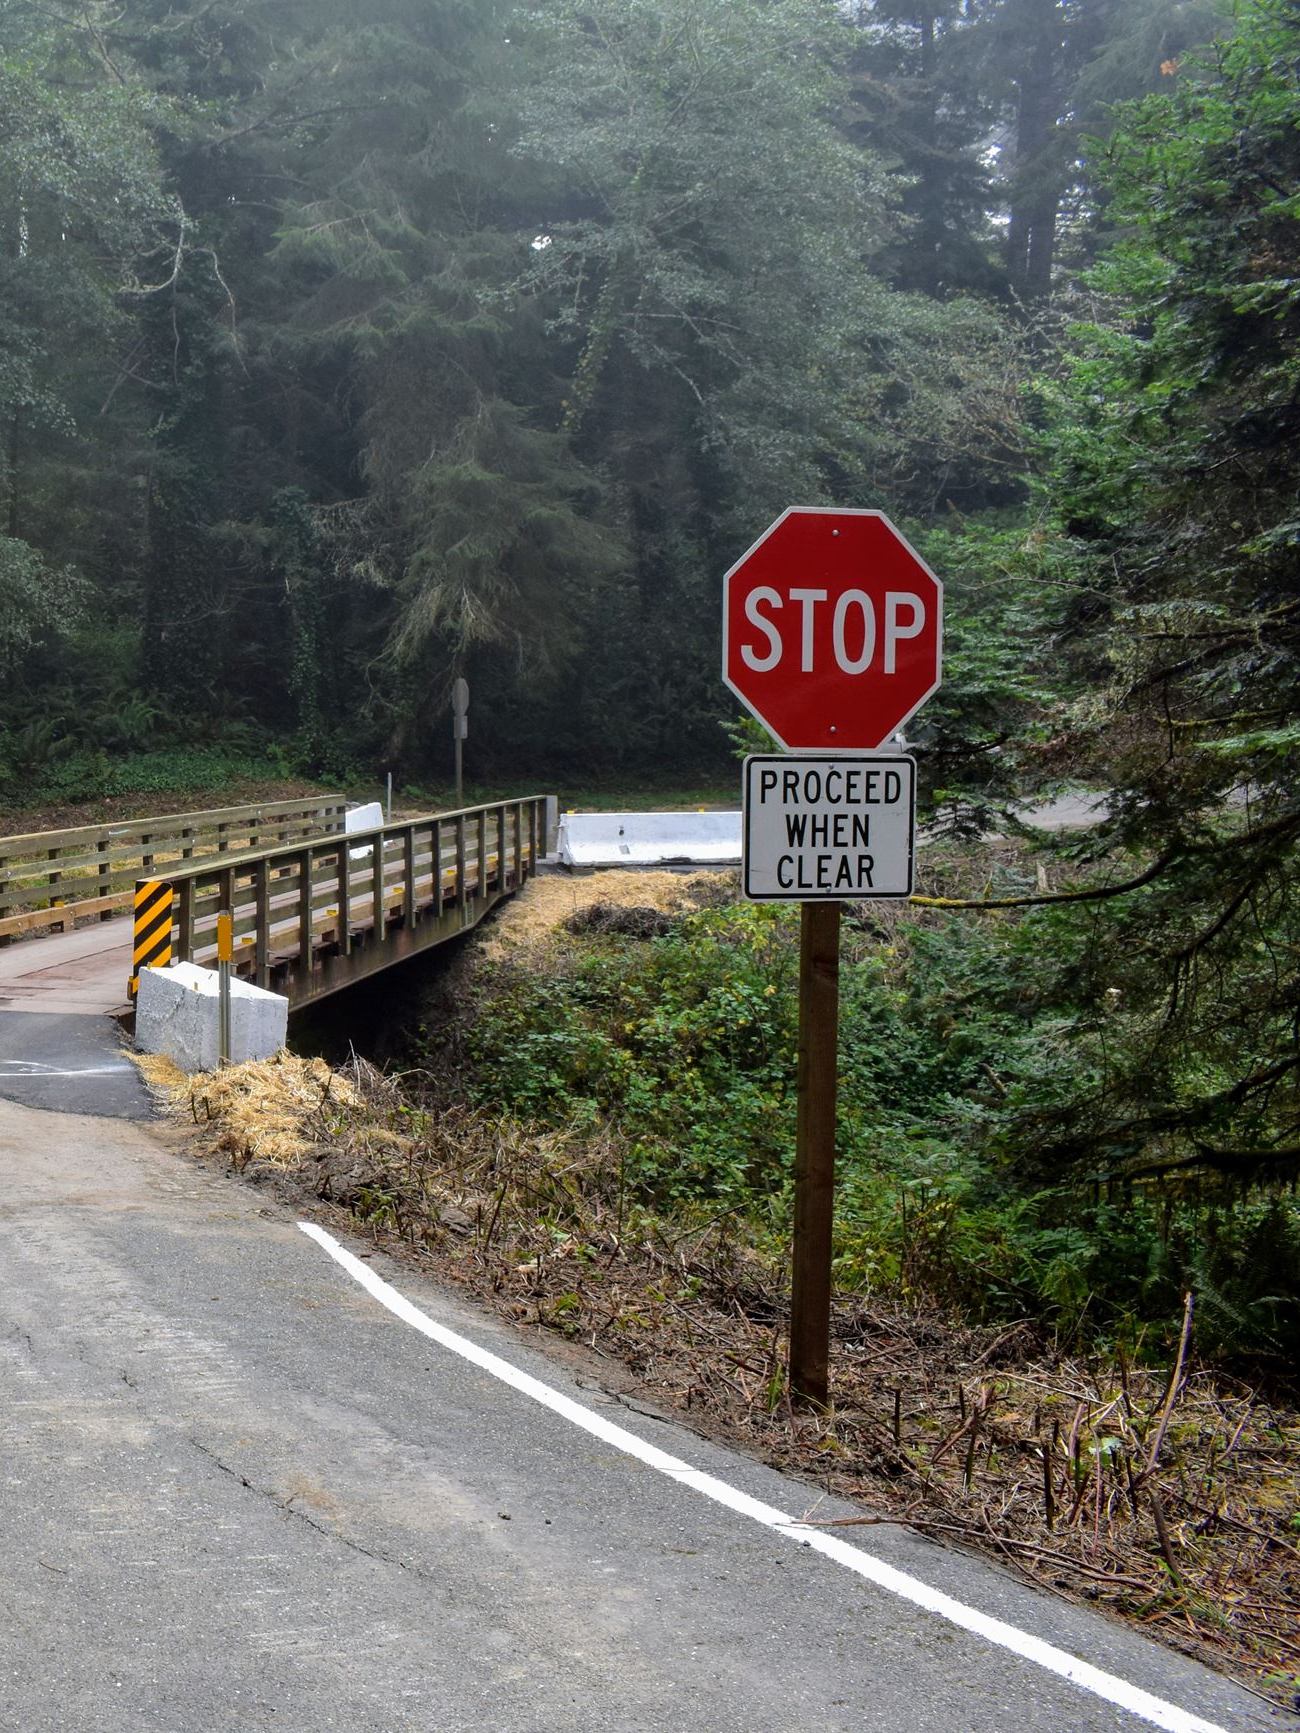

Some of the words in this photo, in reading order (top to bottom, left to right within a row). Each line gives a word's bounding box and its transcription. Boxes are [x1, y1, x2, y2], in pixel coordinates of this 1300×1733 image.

[740, 586, 926, 675] STOP
[760, 769, 901, 804] PROCEED
[785, 813, 870, 848] WHEN
[777, 854, 875, 889] CLEAR
